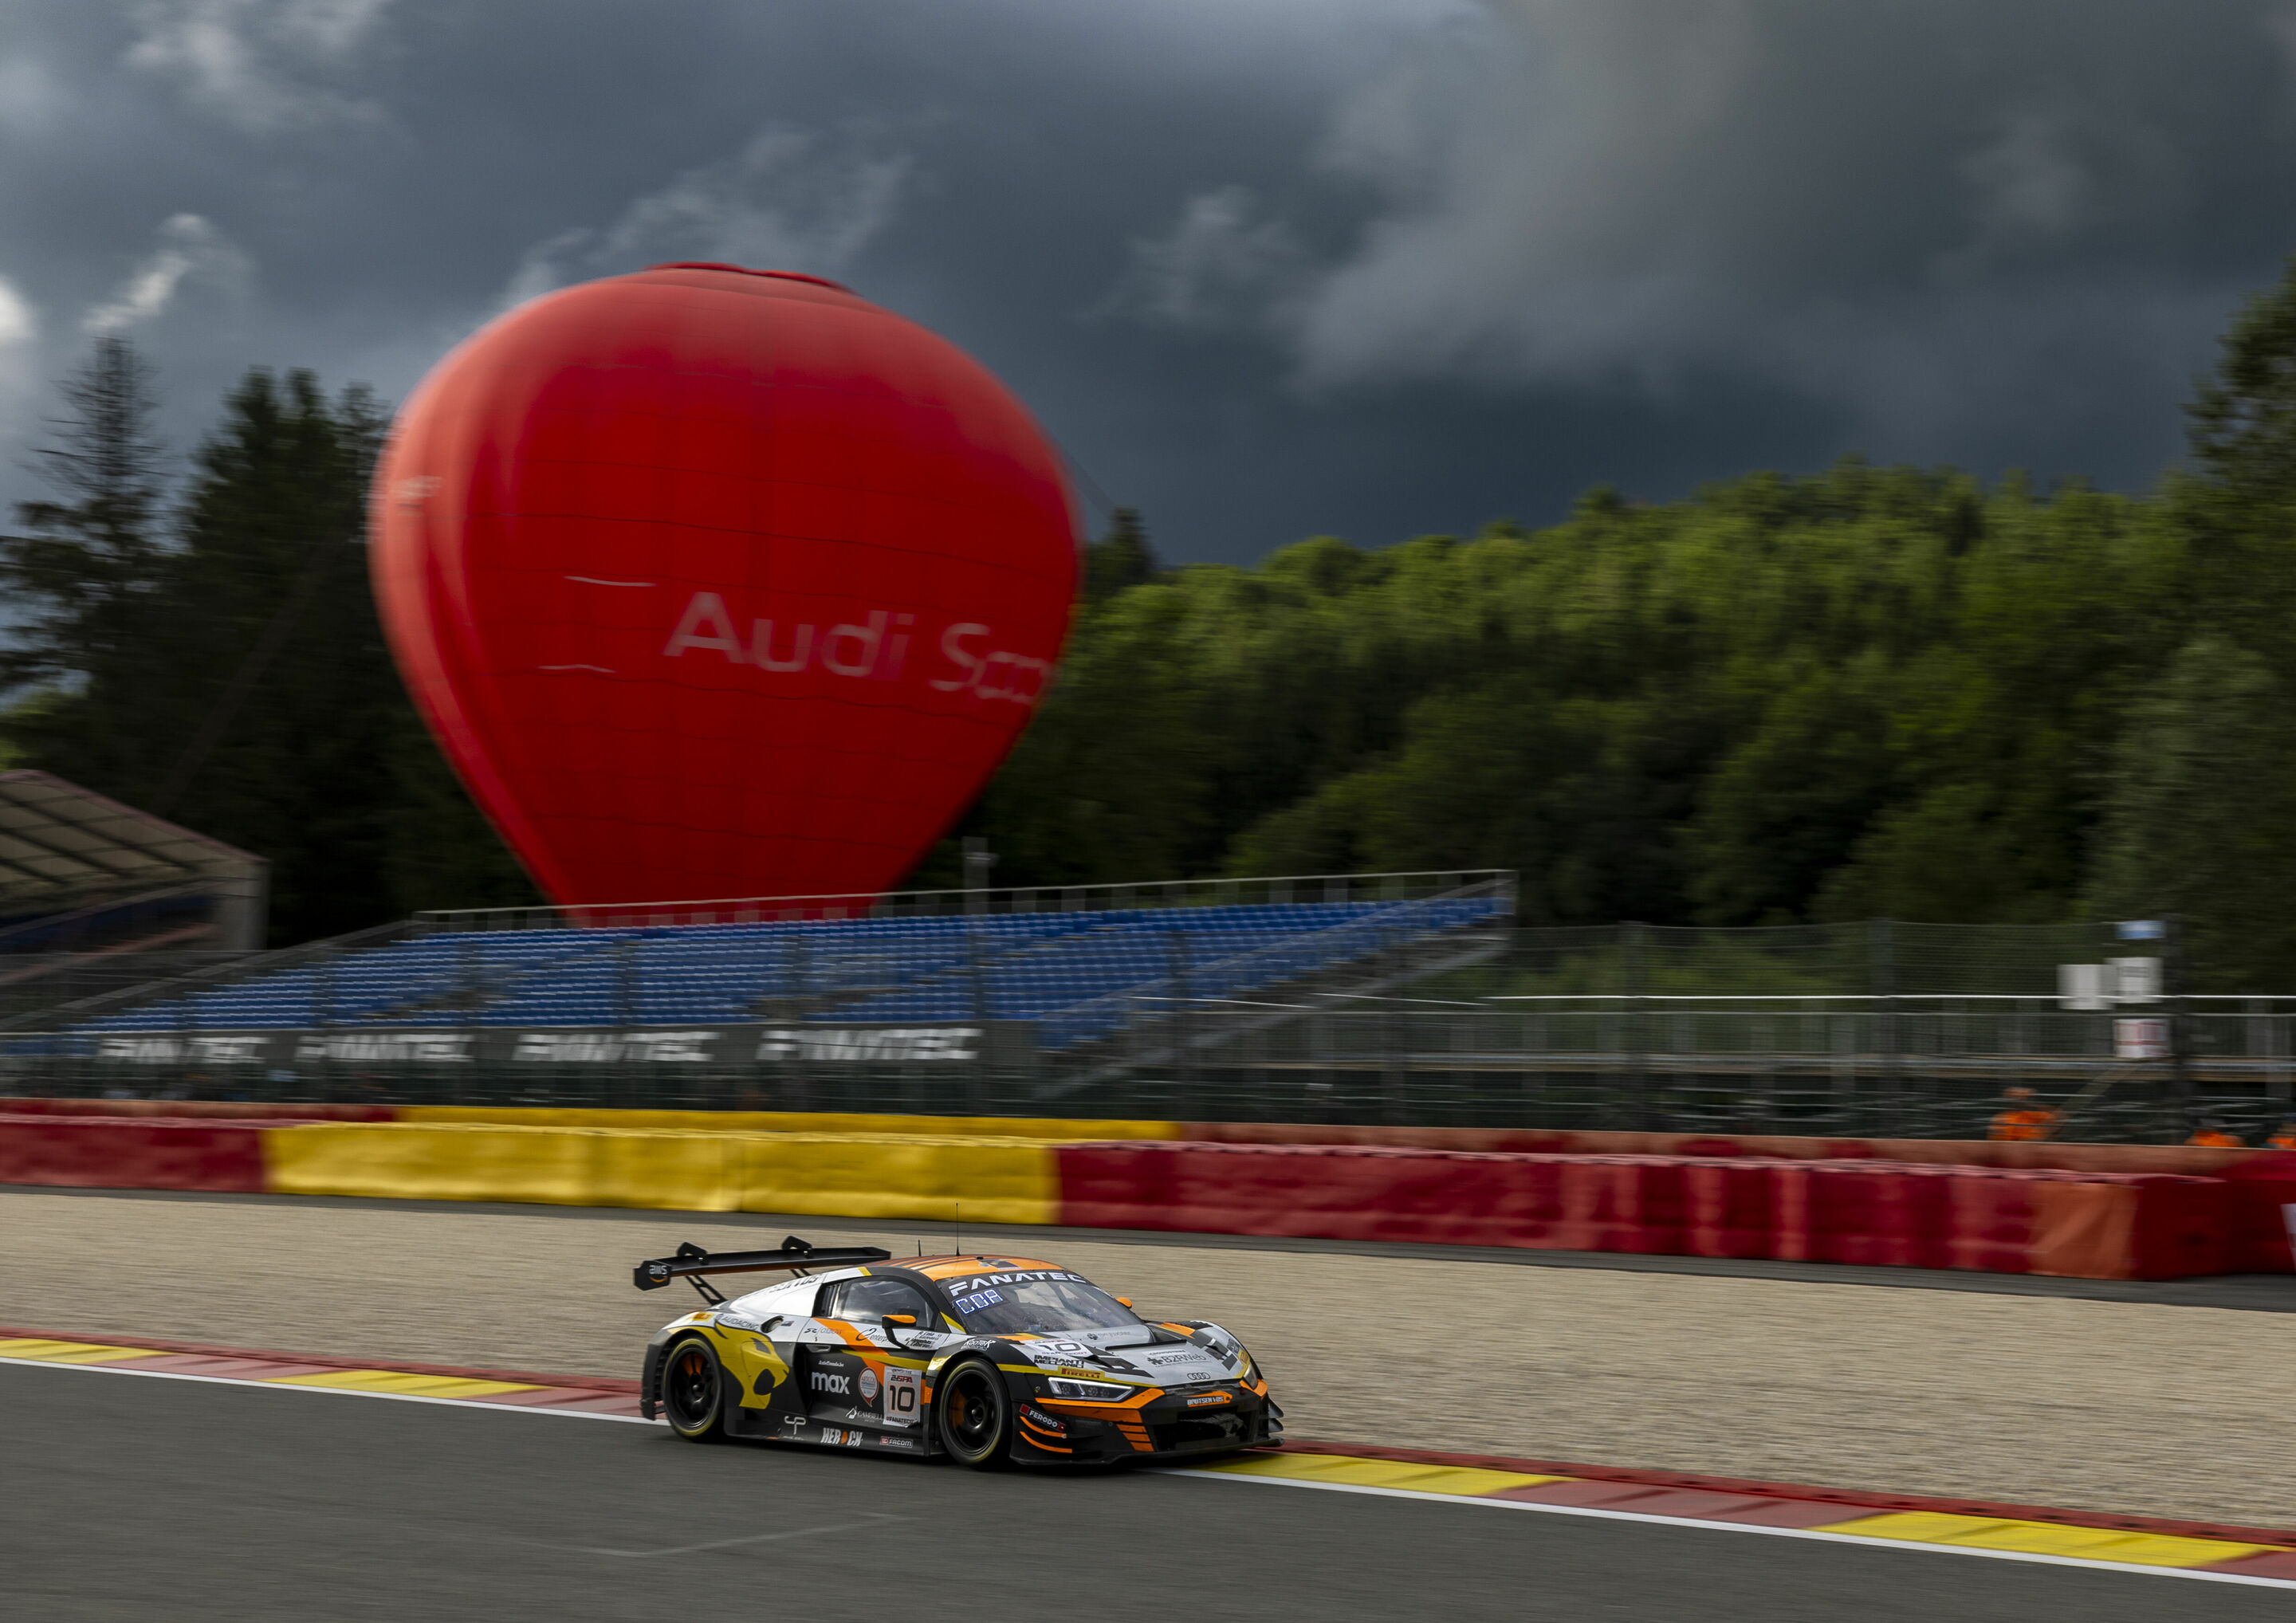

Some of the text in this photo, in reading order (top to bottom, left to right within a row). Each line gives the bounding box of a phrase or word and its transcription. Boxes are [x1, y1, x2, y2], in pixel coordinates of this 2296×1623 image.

[661, 591, 917, 682] Audi
[949, 1271, 1087, 1297] FANATEC
[1161, 1354, 1206, 1364] B2PWeb
[811, 1372, 850, 1395] max
[1061, 1368, 1101, 1378] PIRELLI
[889, 1385, 915, 1413] 10
[1028, 1409, 1059, 1428] FERODO
[889, 1438, 912, 1447] FACOM
